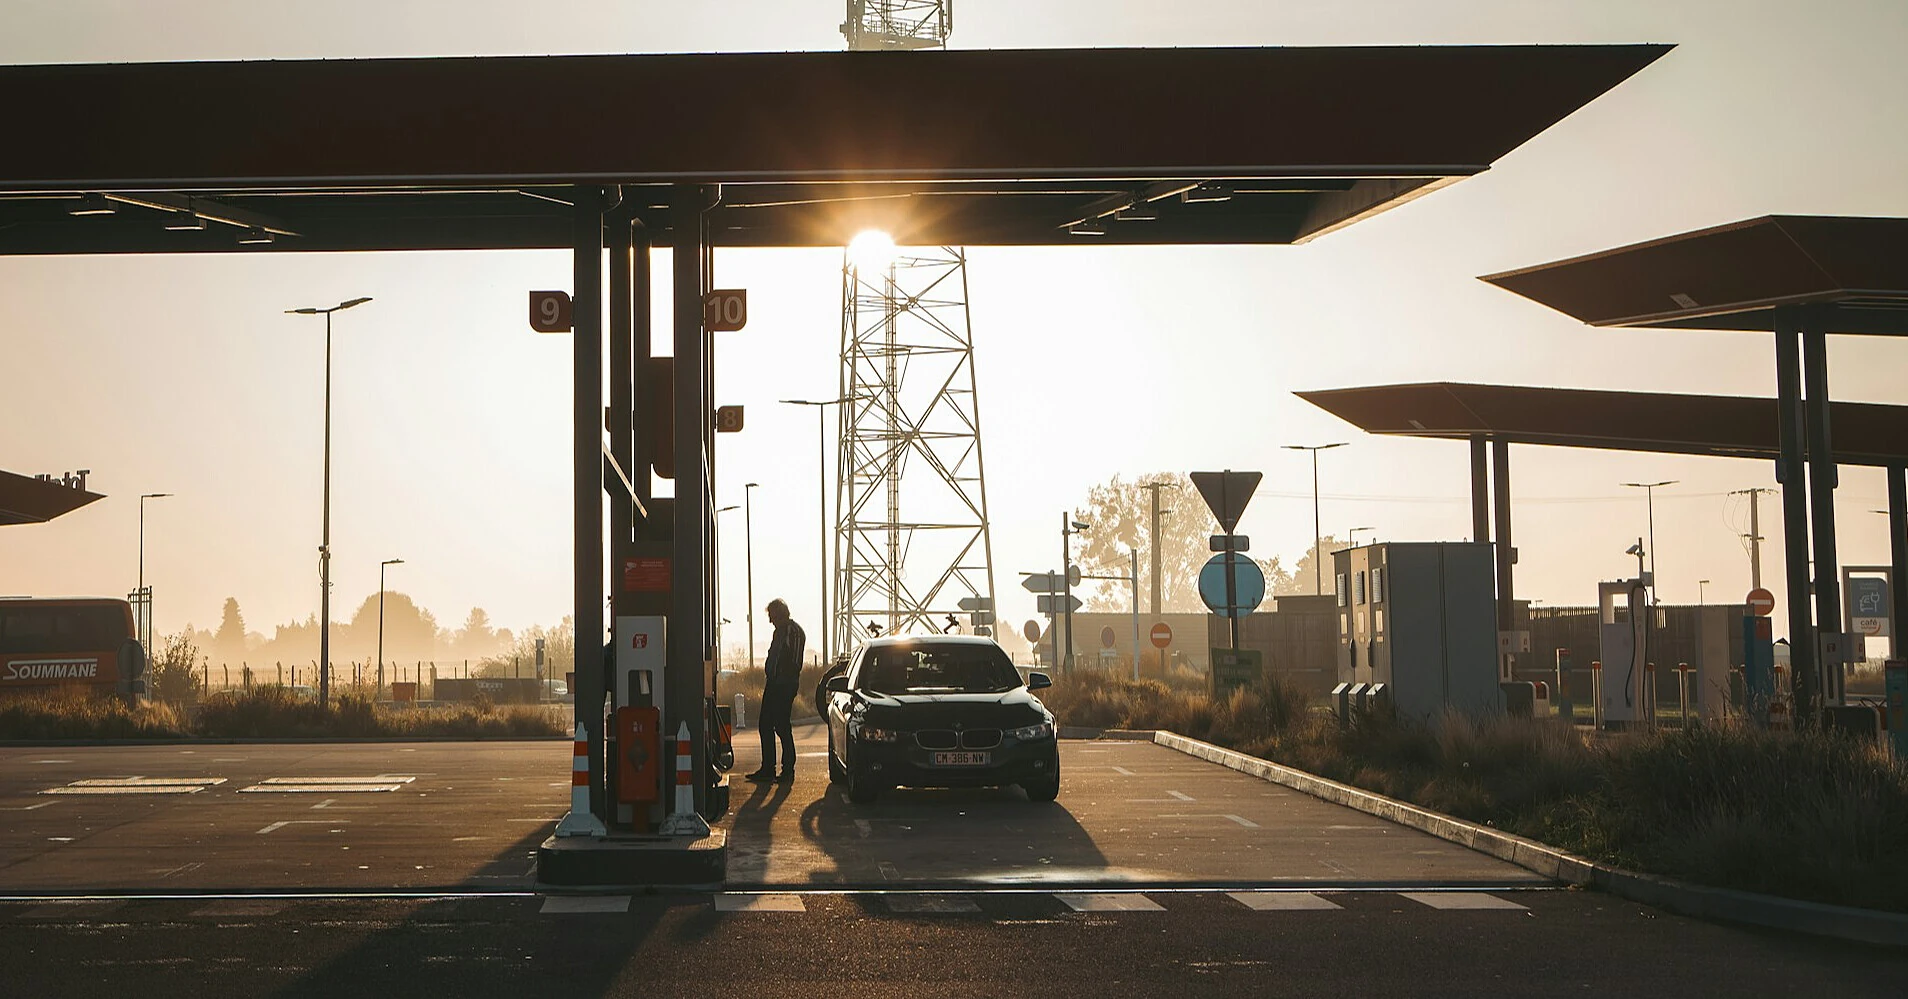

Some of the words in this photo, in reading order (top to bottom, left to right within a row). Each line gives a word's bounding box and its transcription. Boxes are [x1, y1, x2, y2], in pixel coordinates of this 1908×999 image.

[541, 297, 560, 325] 9
[708, 296, 744, 324] 10
[724, 410, 737, 427] 8
